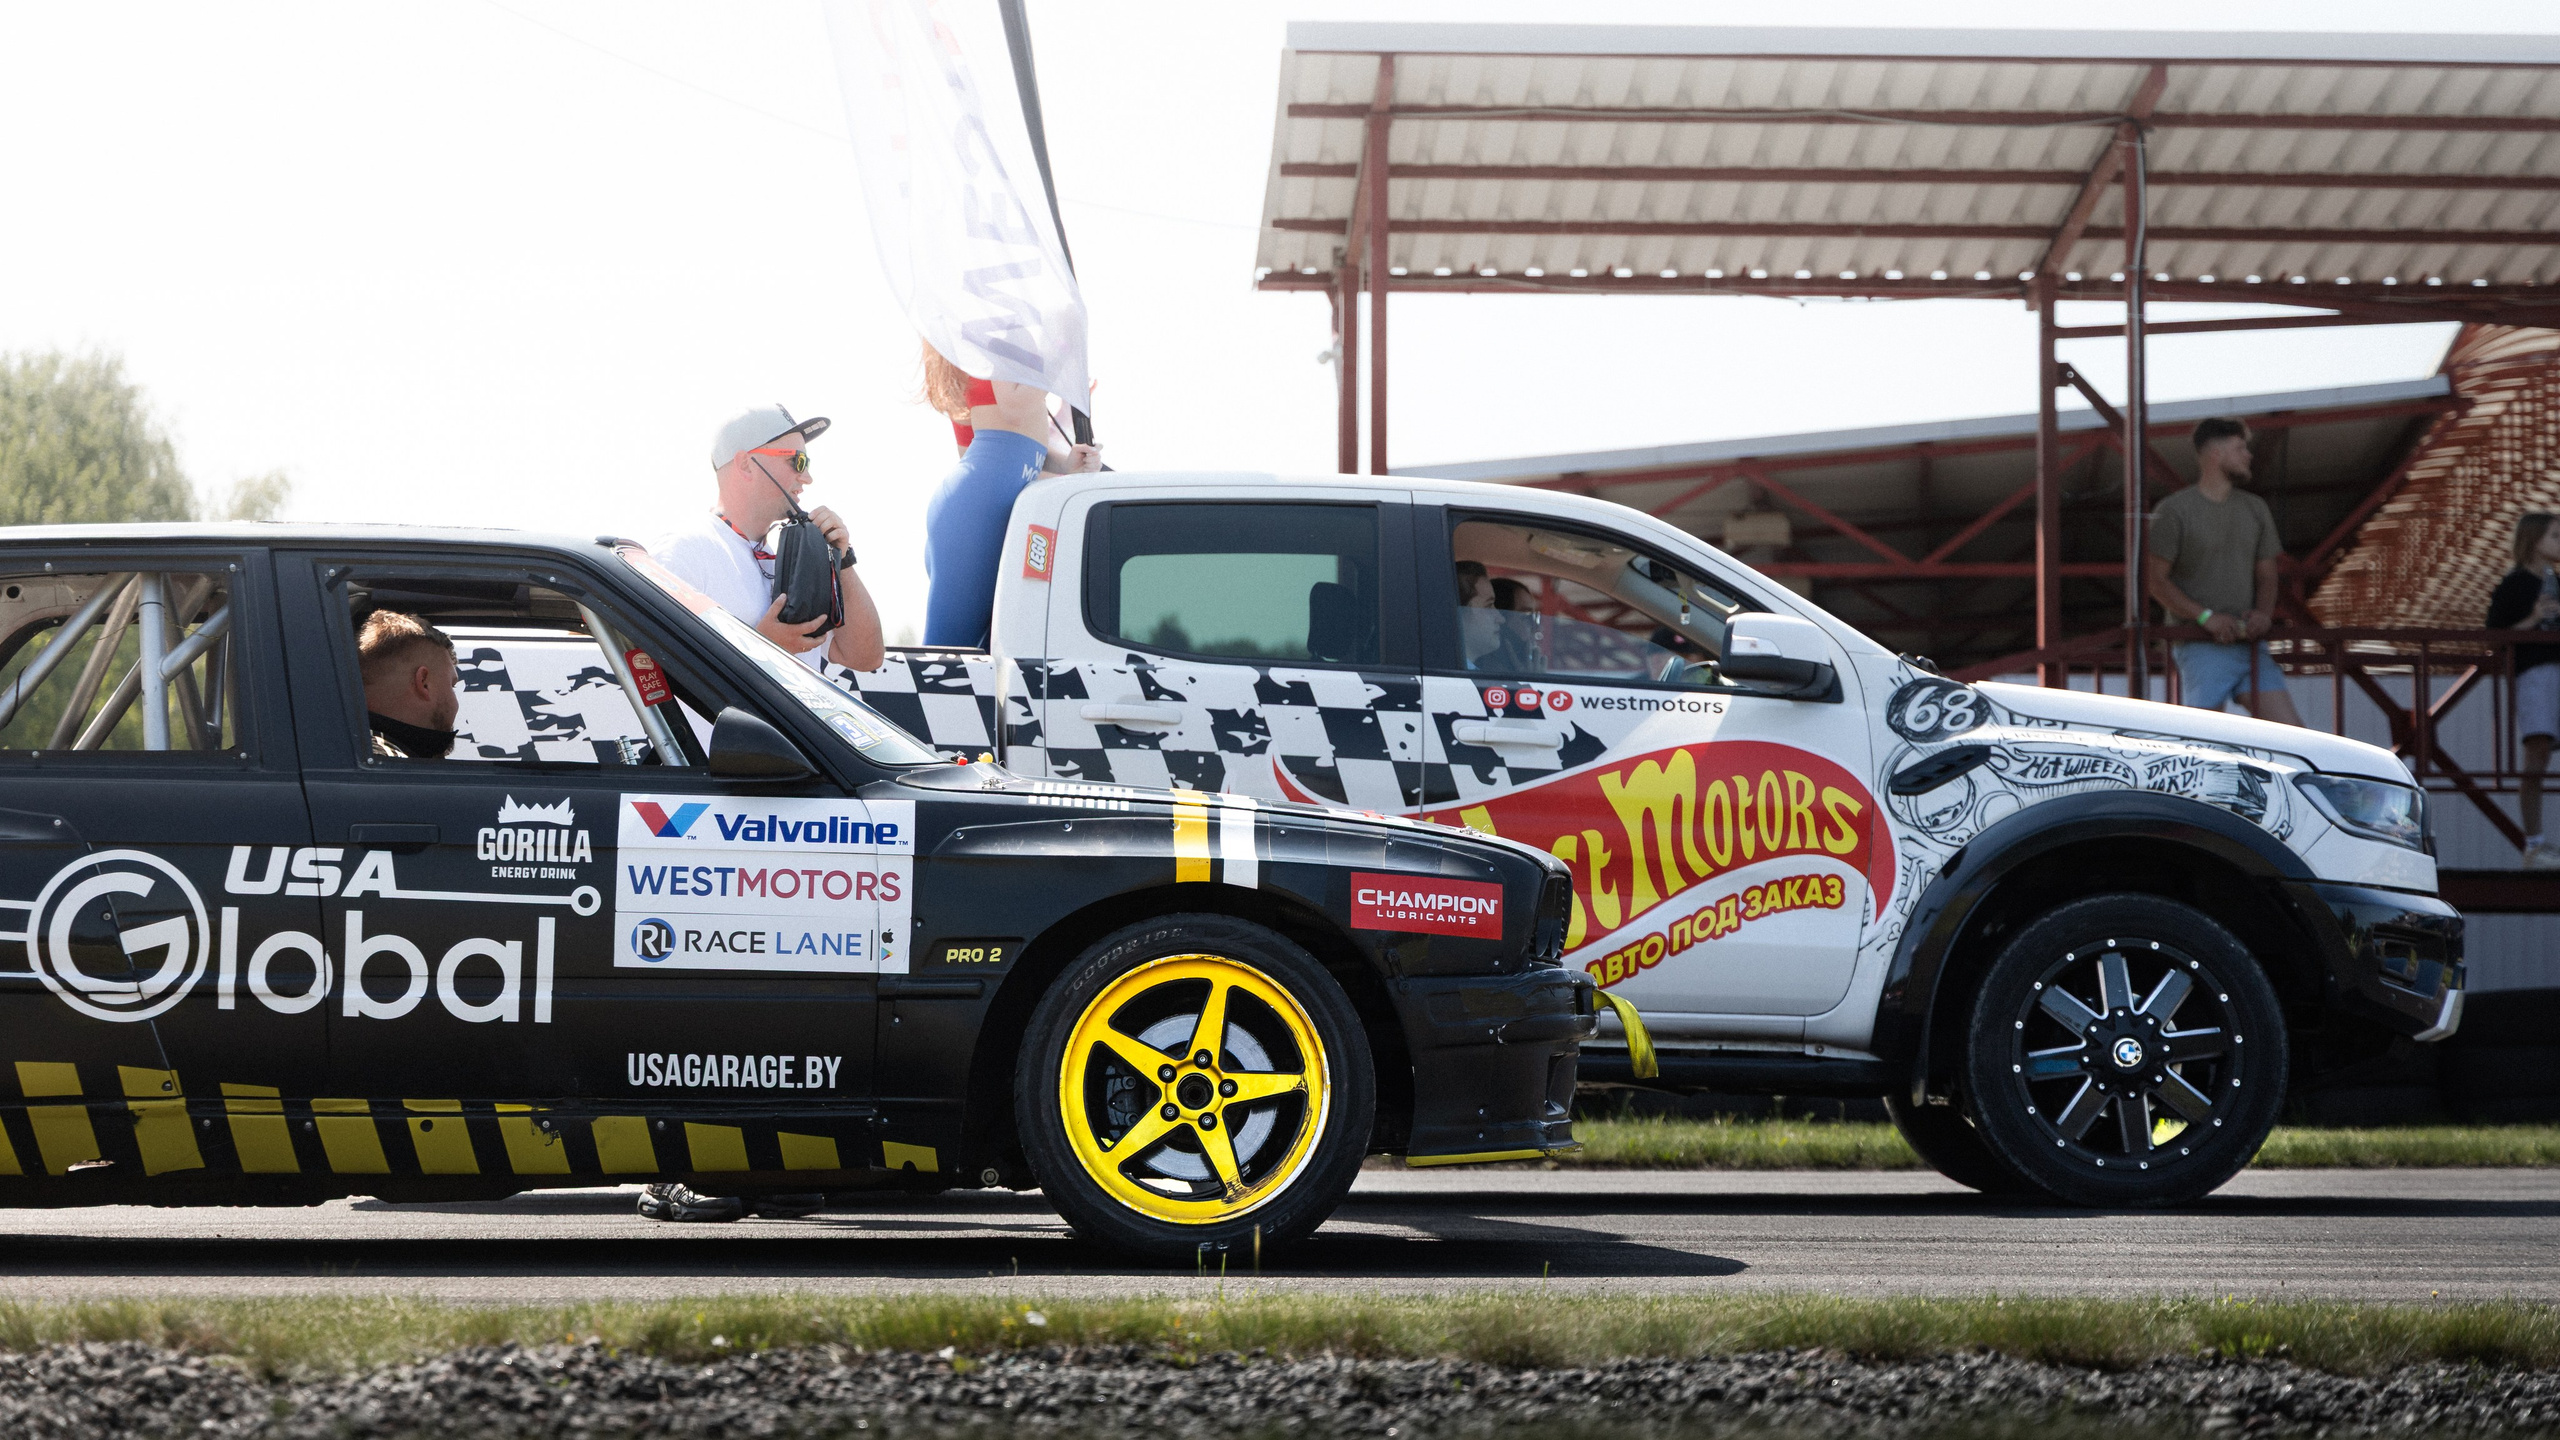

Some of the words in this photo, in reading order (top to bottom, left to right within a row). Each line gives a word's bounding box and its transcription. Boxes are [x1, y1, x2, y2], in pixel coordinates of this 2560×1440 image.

[1028, 533, 1048, 572] LEGO
[639, 671, 658, 684] PLAY
[642, 679, 662, 692] SAFE
[1580, 695, 1724, 715] westmotors
[1905, 685, 1977, 733] 68
[477, 827, 593, 863] GORILLA
[714, 813, 899, 845] Valvoline
[224, 845, 398, 899] USA
[491, 866, 538, 879] ENERGY
[540, 867, 576, 880] DRINK
[628, 865, 901, 902] WESTMOTORS
[1376, 909, 1477, 925] LUBRICANTS
[1585, 935, 1665, 987] АВТО
[1671, 896, 1739, 953] ПОД
[1745, 877, 1843, 919] ЗАКАЗ
[48, 871, 555, 1024] Global
[685, 930, 766, 954] RACE
[775, 932, 862, 957] LANE
[945, 948, 984, 963] PRO
[988, 947, 1002, 962] 2
[627, 1052, 842, 1089] USAGARAGE.BY
